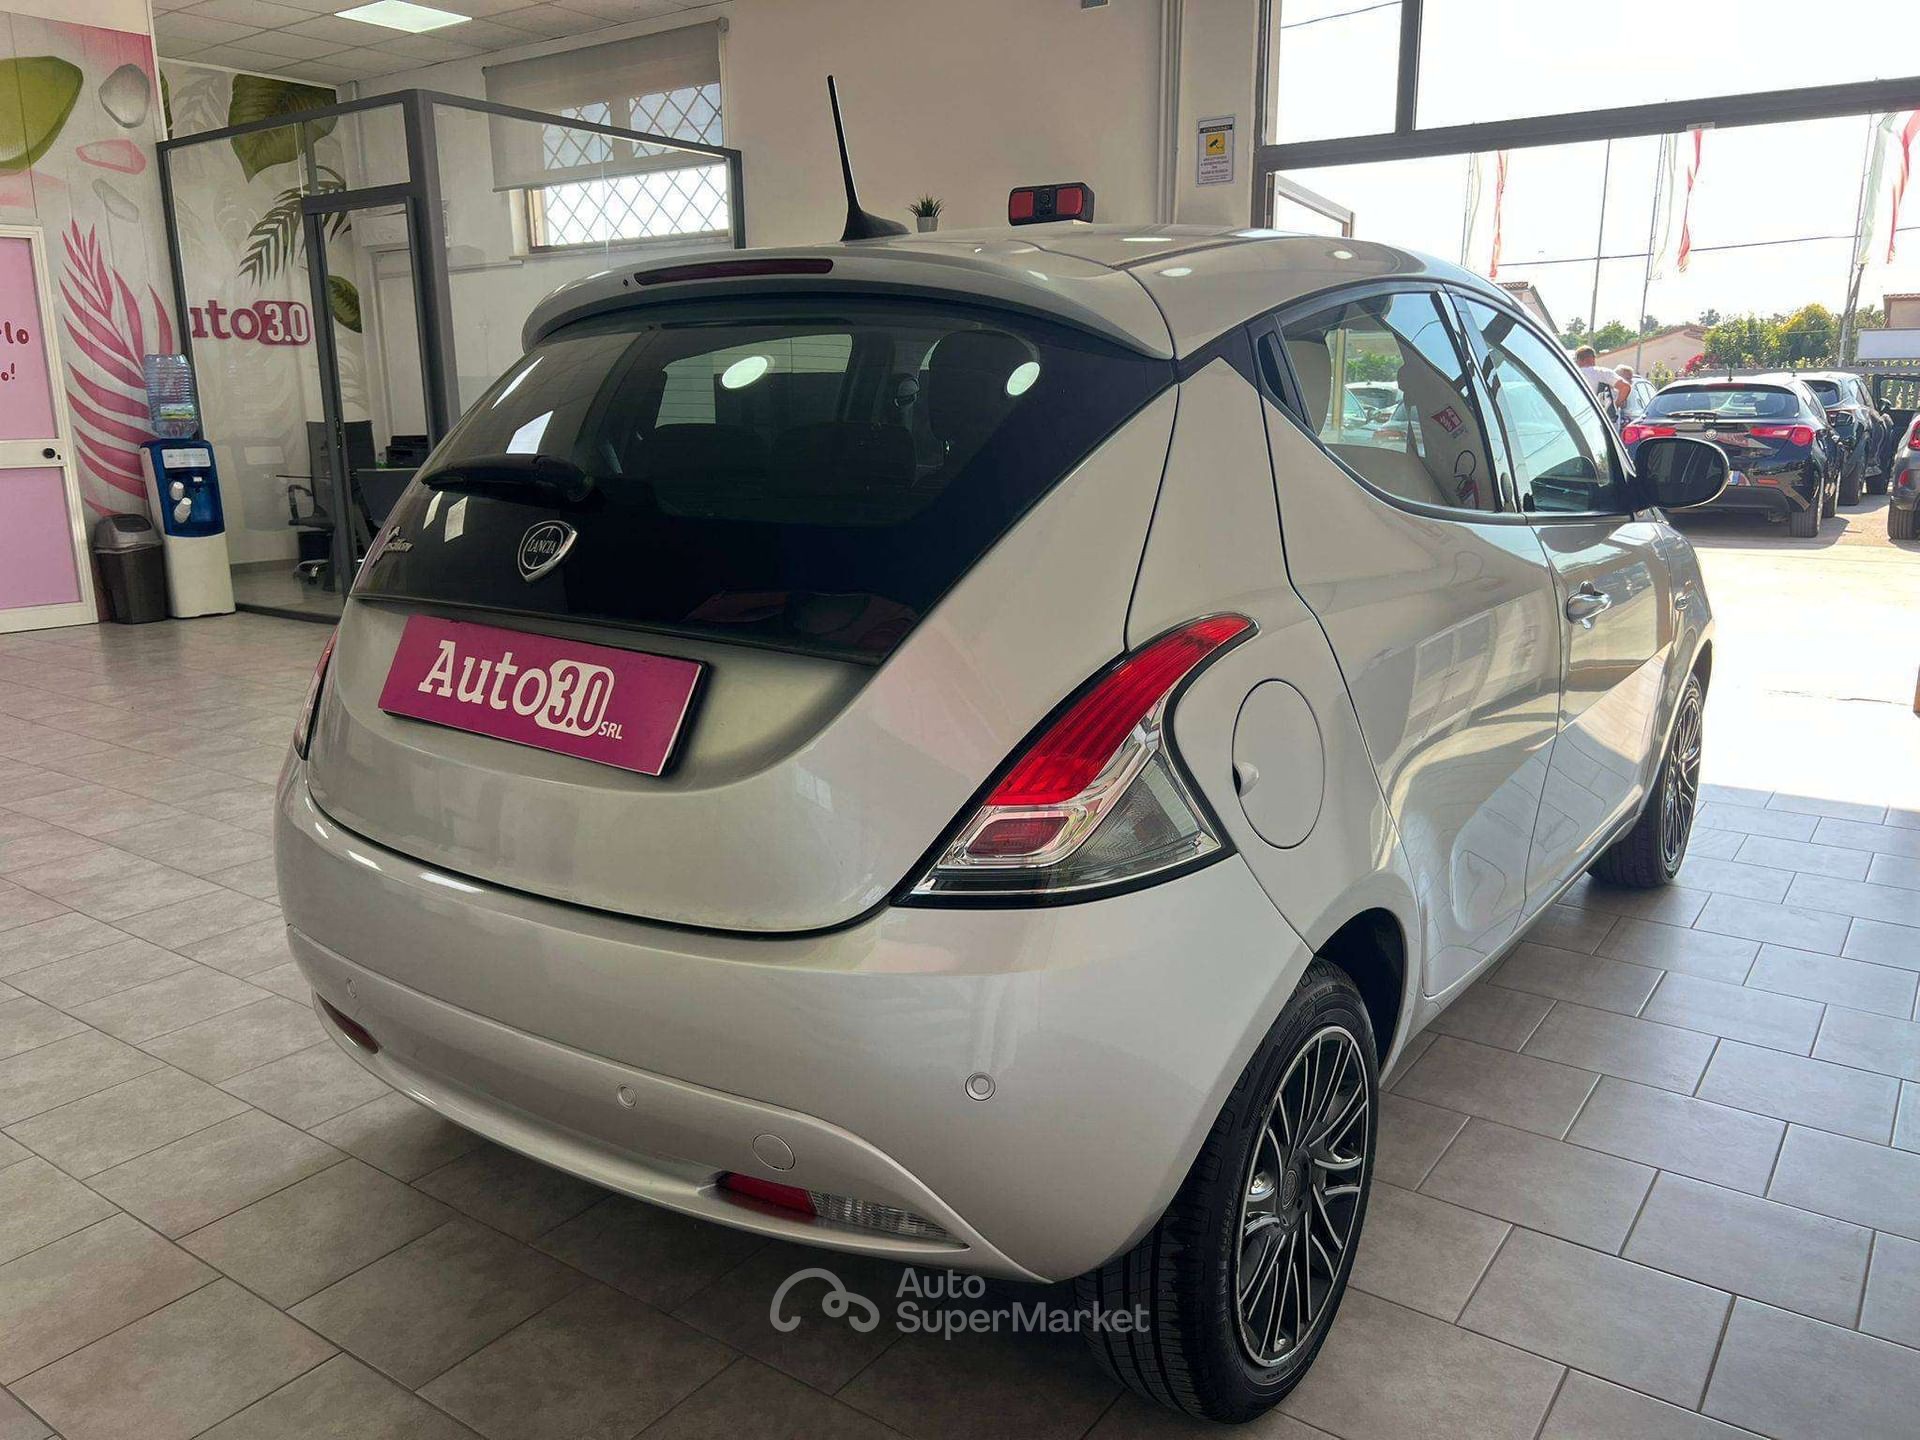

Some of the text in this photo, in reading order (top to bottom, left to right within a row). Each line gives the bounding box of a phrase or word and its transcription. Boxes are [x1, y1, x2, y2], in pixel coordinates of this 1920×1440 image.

[0, 321, 29, 345] lo
[527, 539, 558, 554] LANCIA
[598, 721, 623, 740] SRL
